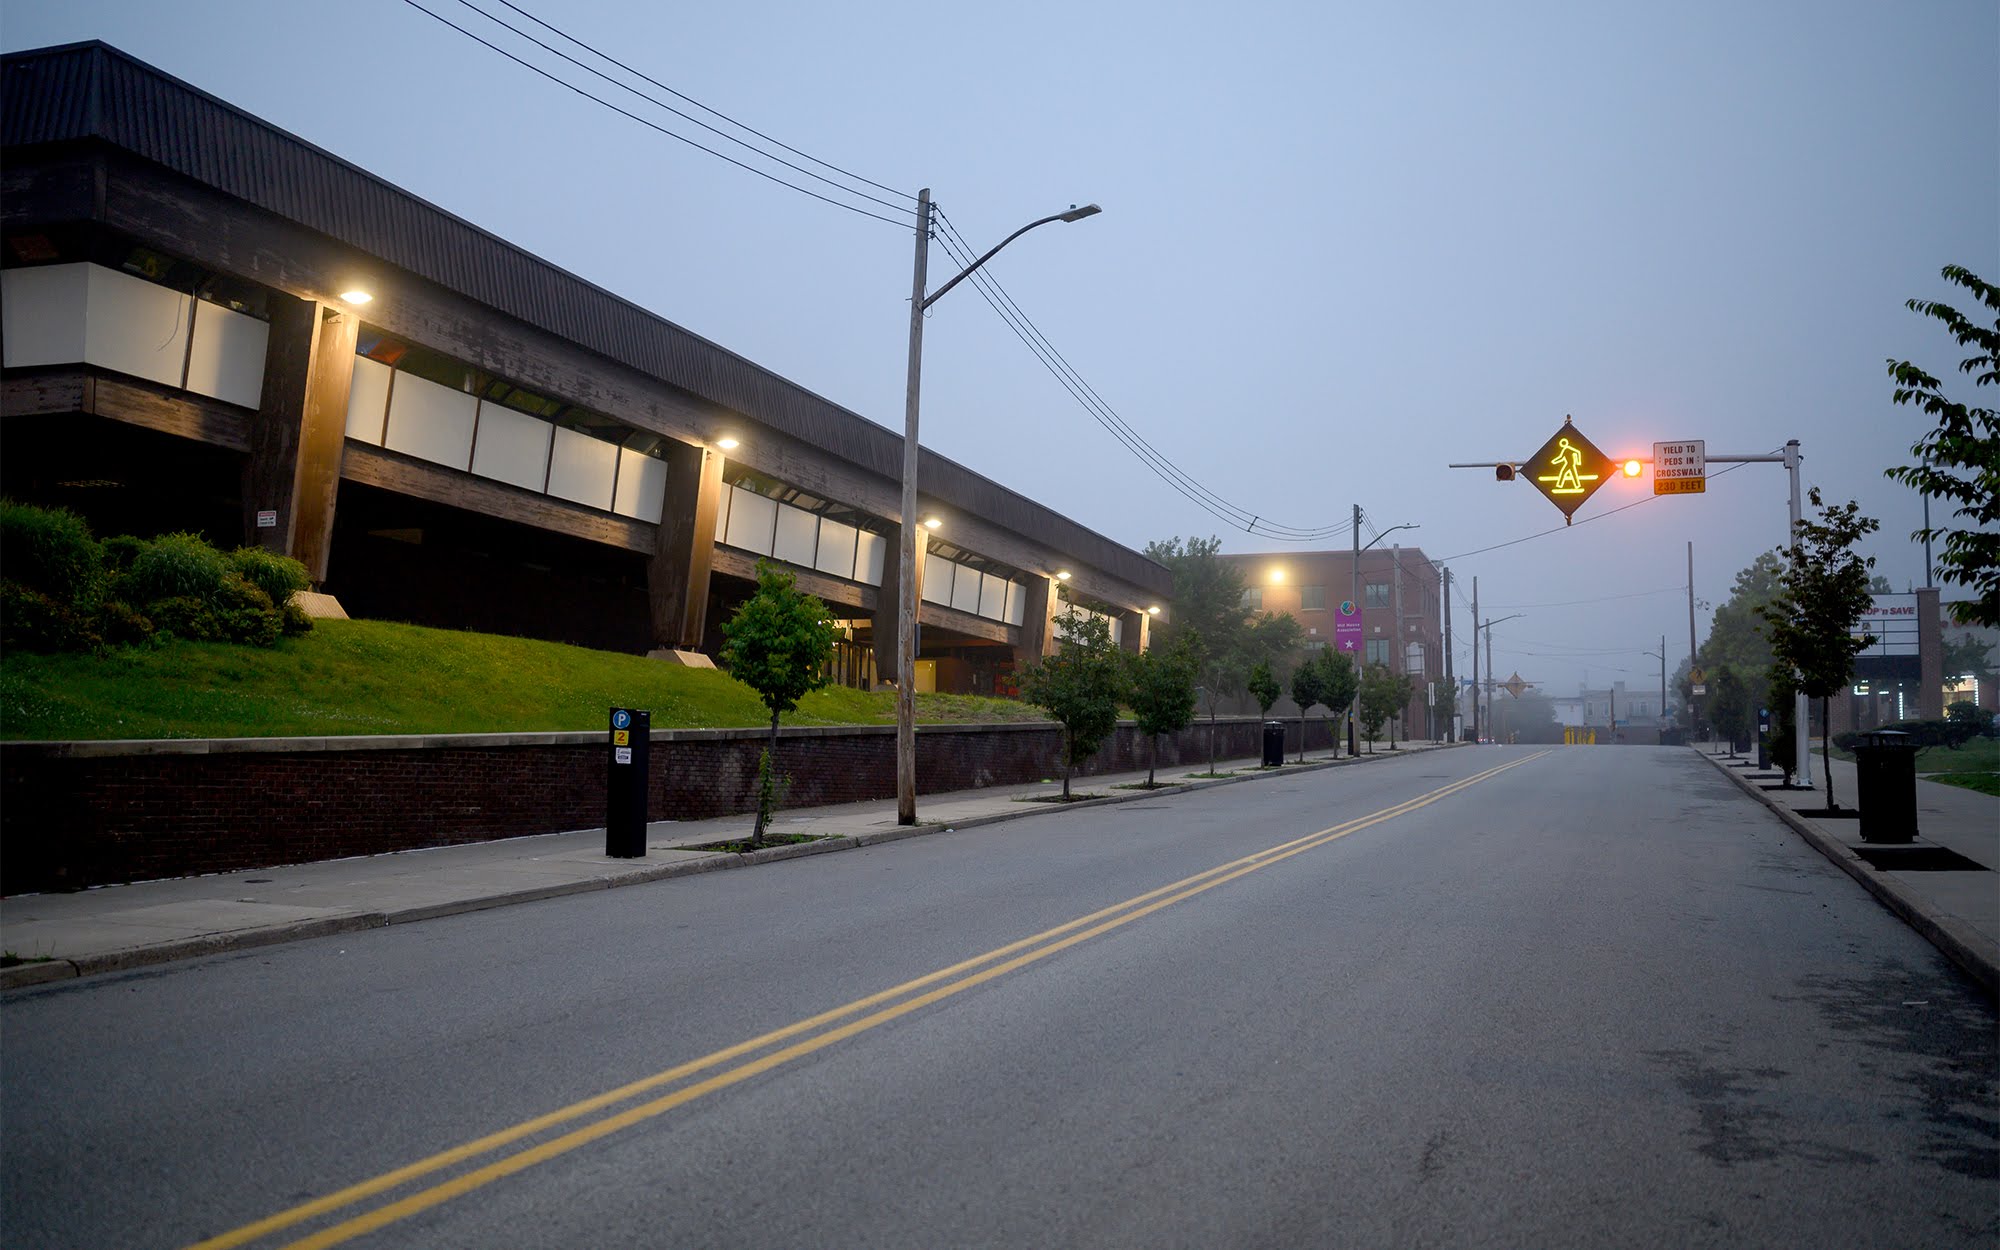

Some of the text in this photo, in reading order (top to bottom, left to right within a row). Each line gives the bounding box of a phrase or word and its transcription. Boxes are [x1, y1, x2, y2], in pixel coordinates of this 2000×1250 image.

[1663, 445, 1696, 454] YIELD TO
[1664, 456, 1695, 466] PEDS IN
[1656, 467, 1703, 478] CROSSWALK
[1657, 480, 1702, 492] 230 FEET
[1890, 607, 1915, 615] SAVE
[618, 713, 627, 726] P
[617, 731, 625, 742] 2
